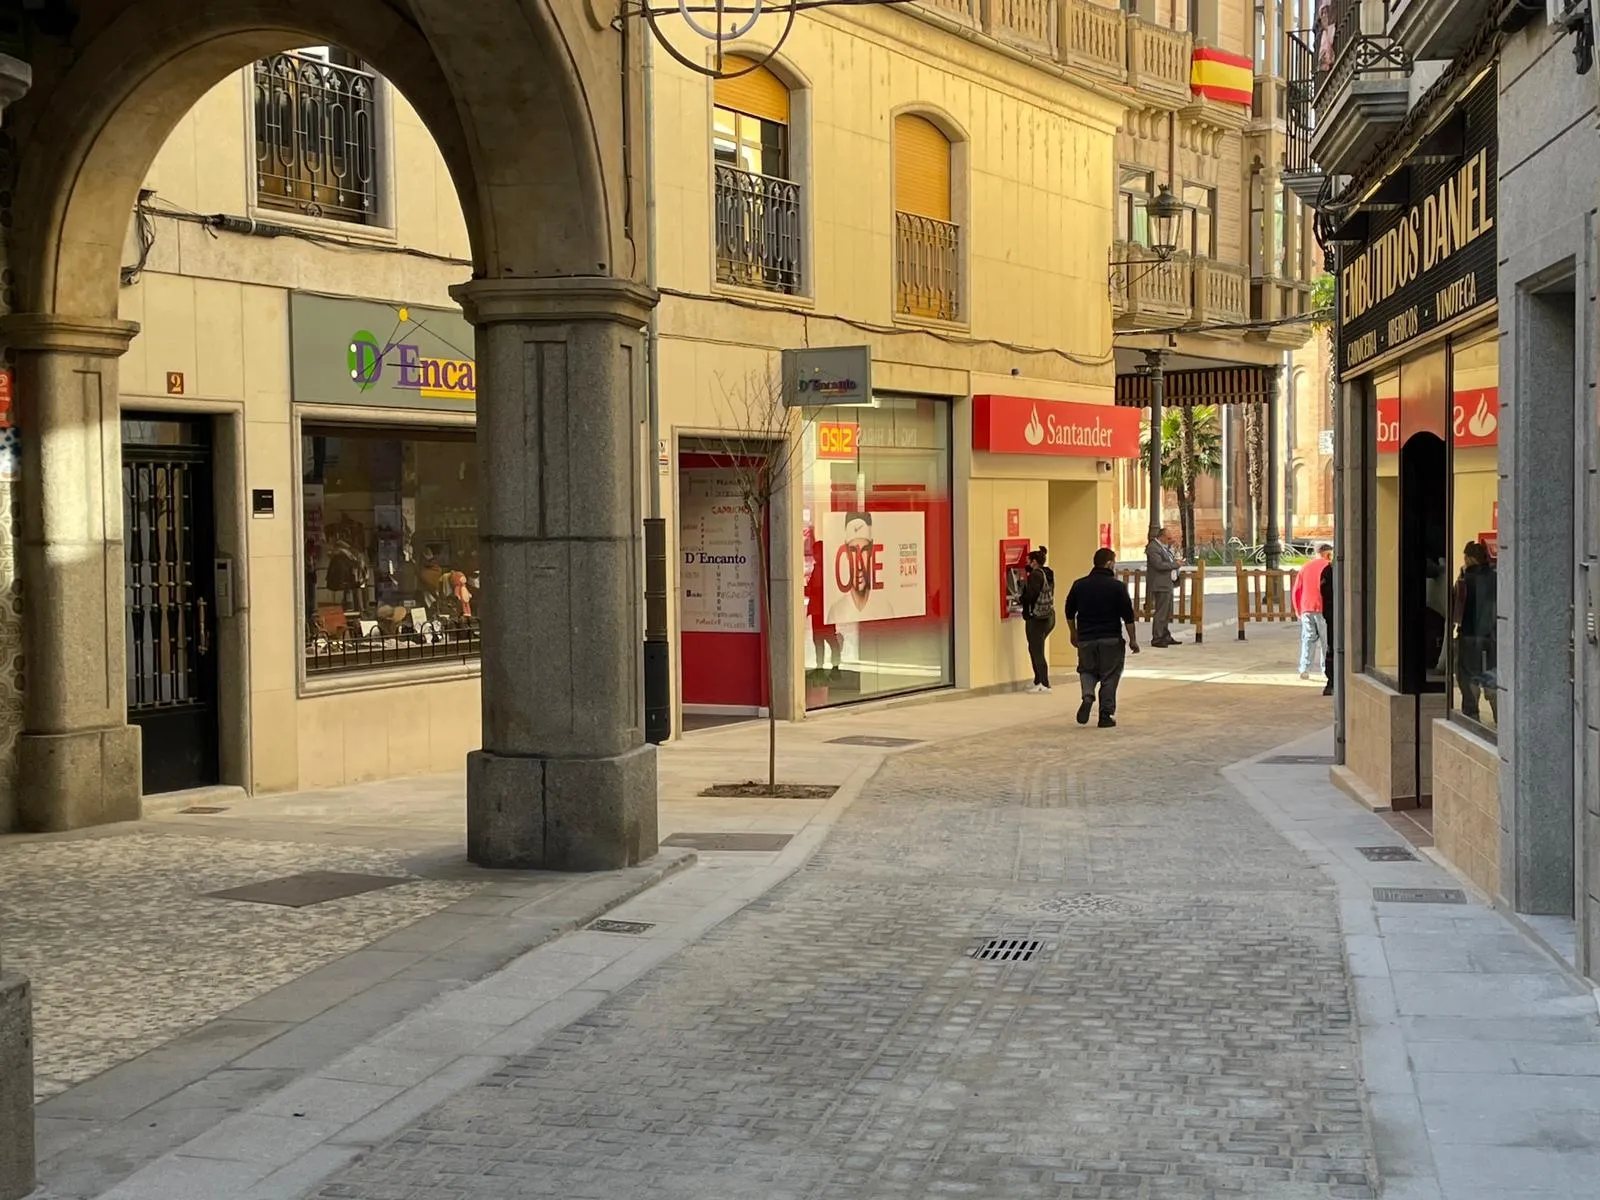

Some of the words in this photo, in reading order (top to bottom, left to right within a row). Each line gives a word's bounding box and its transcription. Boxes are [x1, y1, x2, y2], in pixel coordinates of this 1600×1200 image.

[1342, 205, 1420, 326] EMBUTIDOS
[1423, 147, 1493, 272] DANIEL
[1436, 272, 1476, 322] VINOTECA
[351, 340, 475, 391] D´Enca
[1047, 414, 1113, 447] Santander
[835, 543, 884, 593] ONE
[900, 565, 917, 577] PLAN
